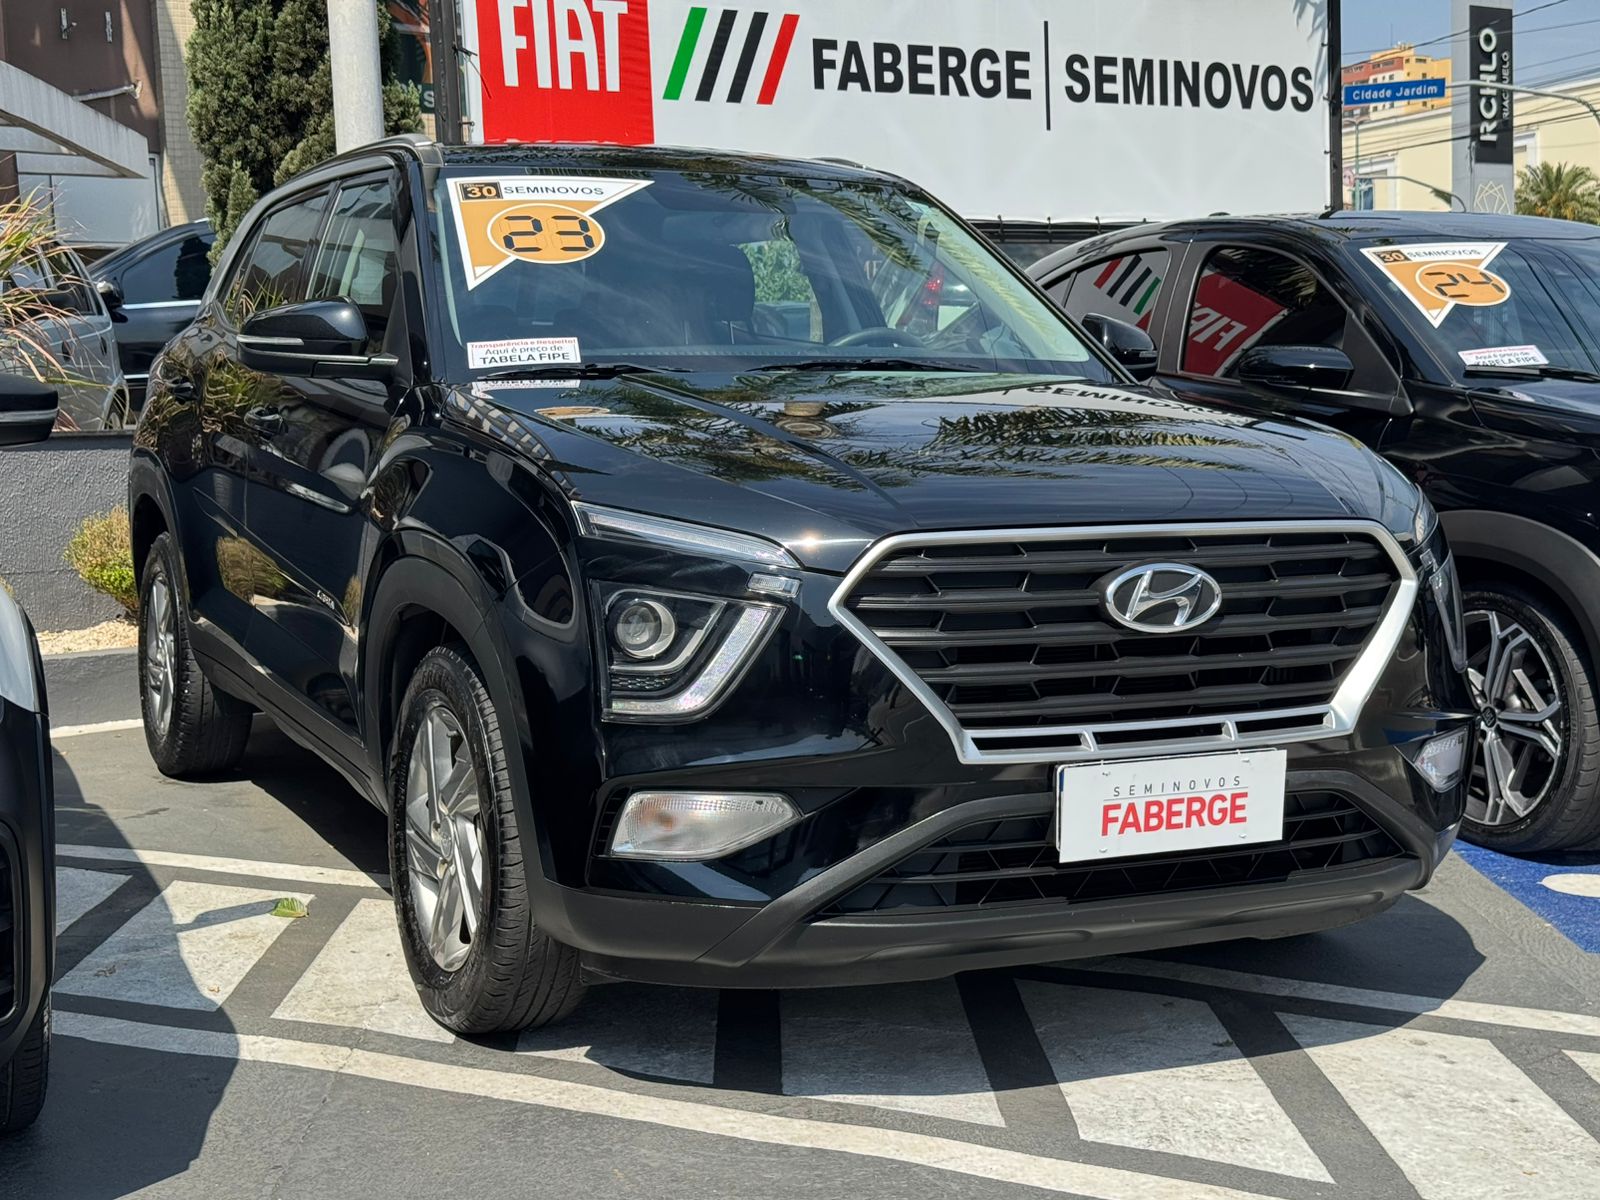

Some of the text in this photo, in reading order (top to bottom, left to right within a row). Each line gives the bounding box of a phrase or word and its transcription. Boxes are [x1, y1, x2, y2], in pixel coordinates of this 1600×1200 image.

[498, 0, 629, 92] FIAT
[812, 38, 1314, 112] FABERGE SEMINOVOS
[1479, 27, 1498, 142] RCHLO
[1502, 51, 1510, 119] RIACUELO
[1352, 85, 1438, 101] Cidade Jardim
[466, 185, 497, 198] 30
[503, 185, 605, 196] SEMINOVOS
[503, 215, 595, 252] 23
[1380, 248, 1482, 262] 30 SEMINOVOS
[1425, 271, 1505, 298] 24
[470, 340, 529, 350] Transparência
[485, 348, 509, 356] Aqui
[519, 346, 545, 354] preço
[550, 344, 563, 352] de
[480, 352, 571, 365] TABELA FIPE
[1113, 775, 1241, 797] SEMINOVOS
[1101, 792, 1249, 836] FABERGE
